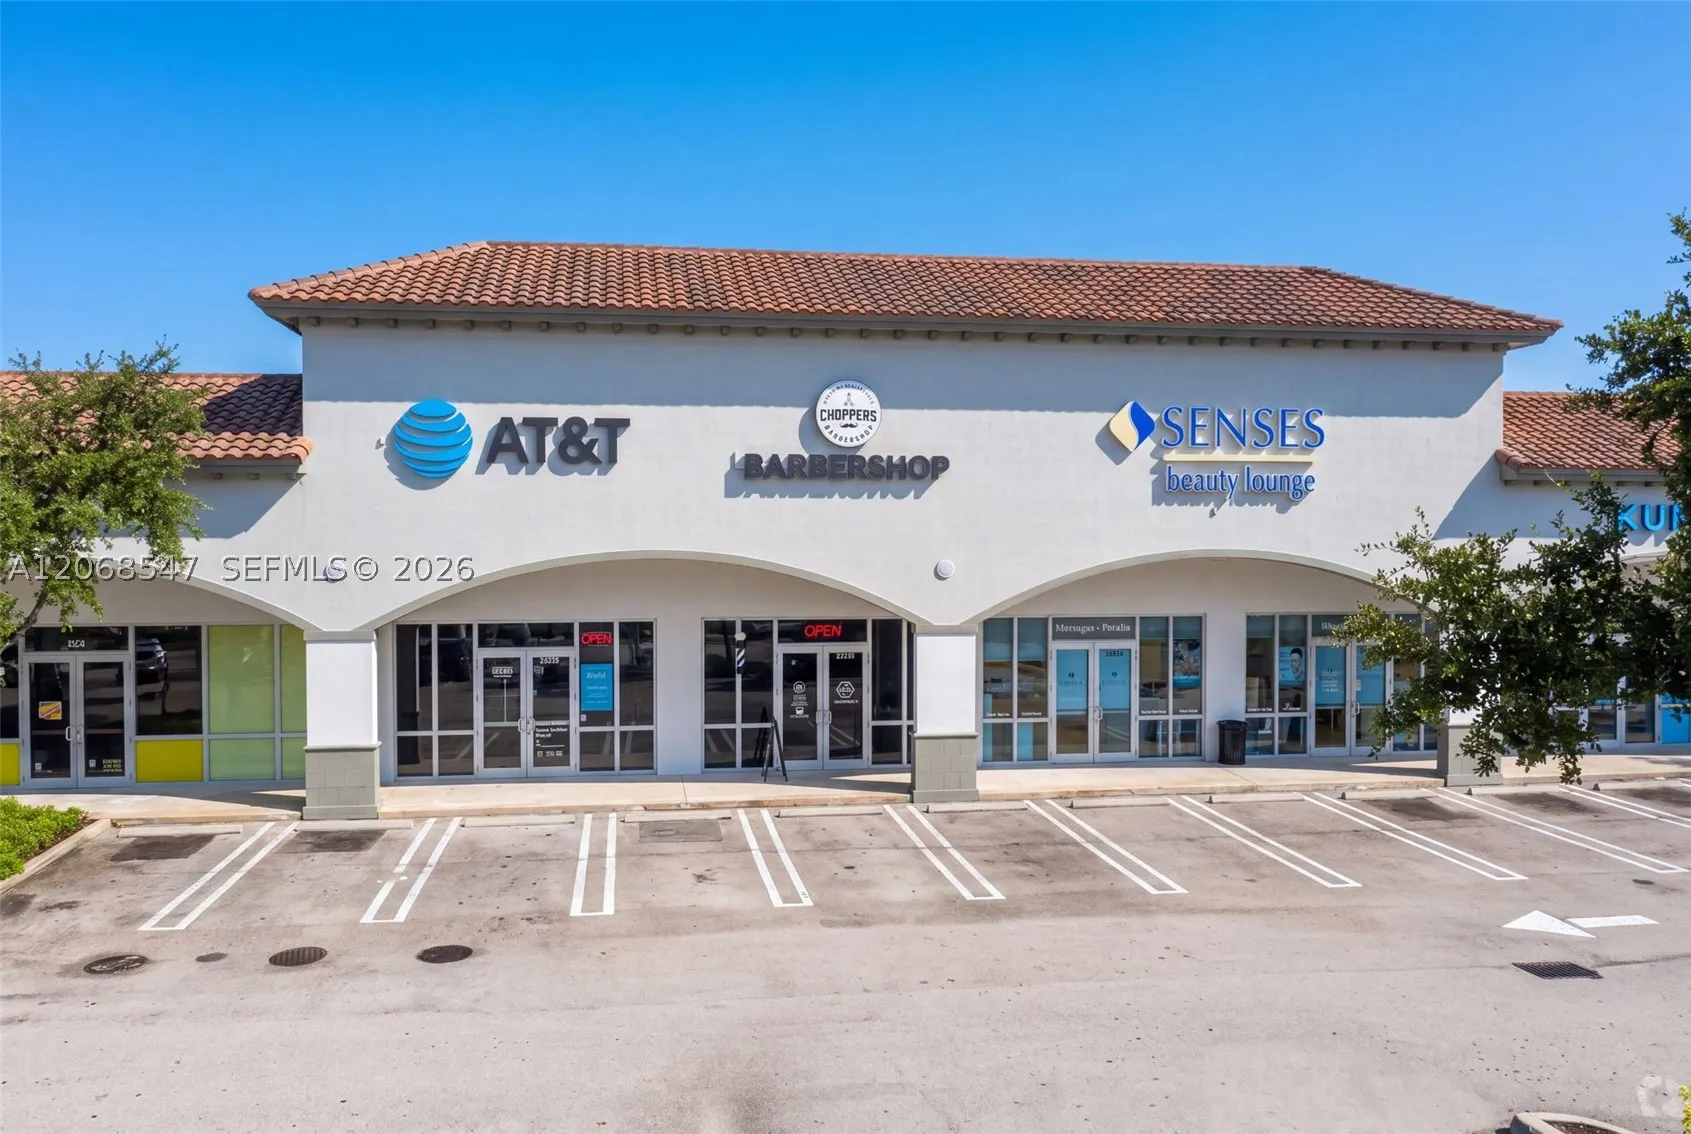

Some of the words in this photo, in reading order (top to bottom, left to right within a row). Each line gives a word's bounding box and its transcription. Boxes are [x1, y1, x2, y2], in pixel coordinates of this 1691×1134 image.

[820, 408, 877, 422] CHOPPERS
[824, 424, 873, 443] BARBERSHOP
[1162, 406, 1325, 449] SENSES
[486, 416, 631, 465] AT&T
[744, 453, 950, 480] BARBERSHOP
[1166, 465, 1239, 500] beauty
[1244, 466, 1316, 501] lounge
[581, 632, 614, 645] OPEN
[804, 624, 842, 637] OPEN
